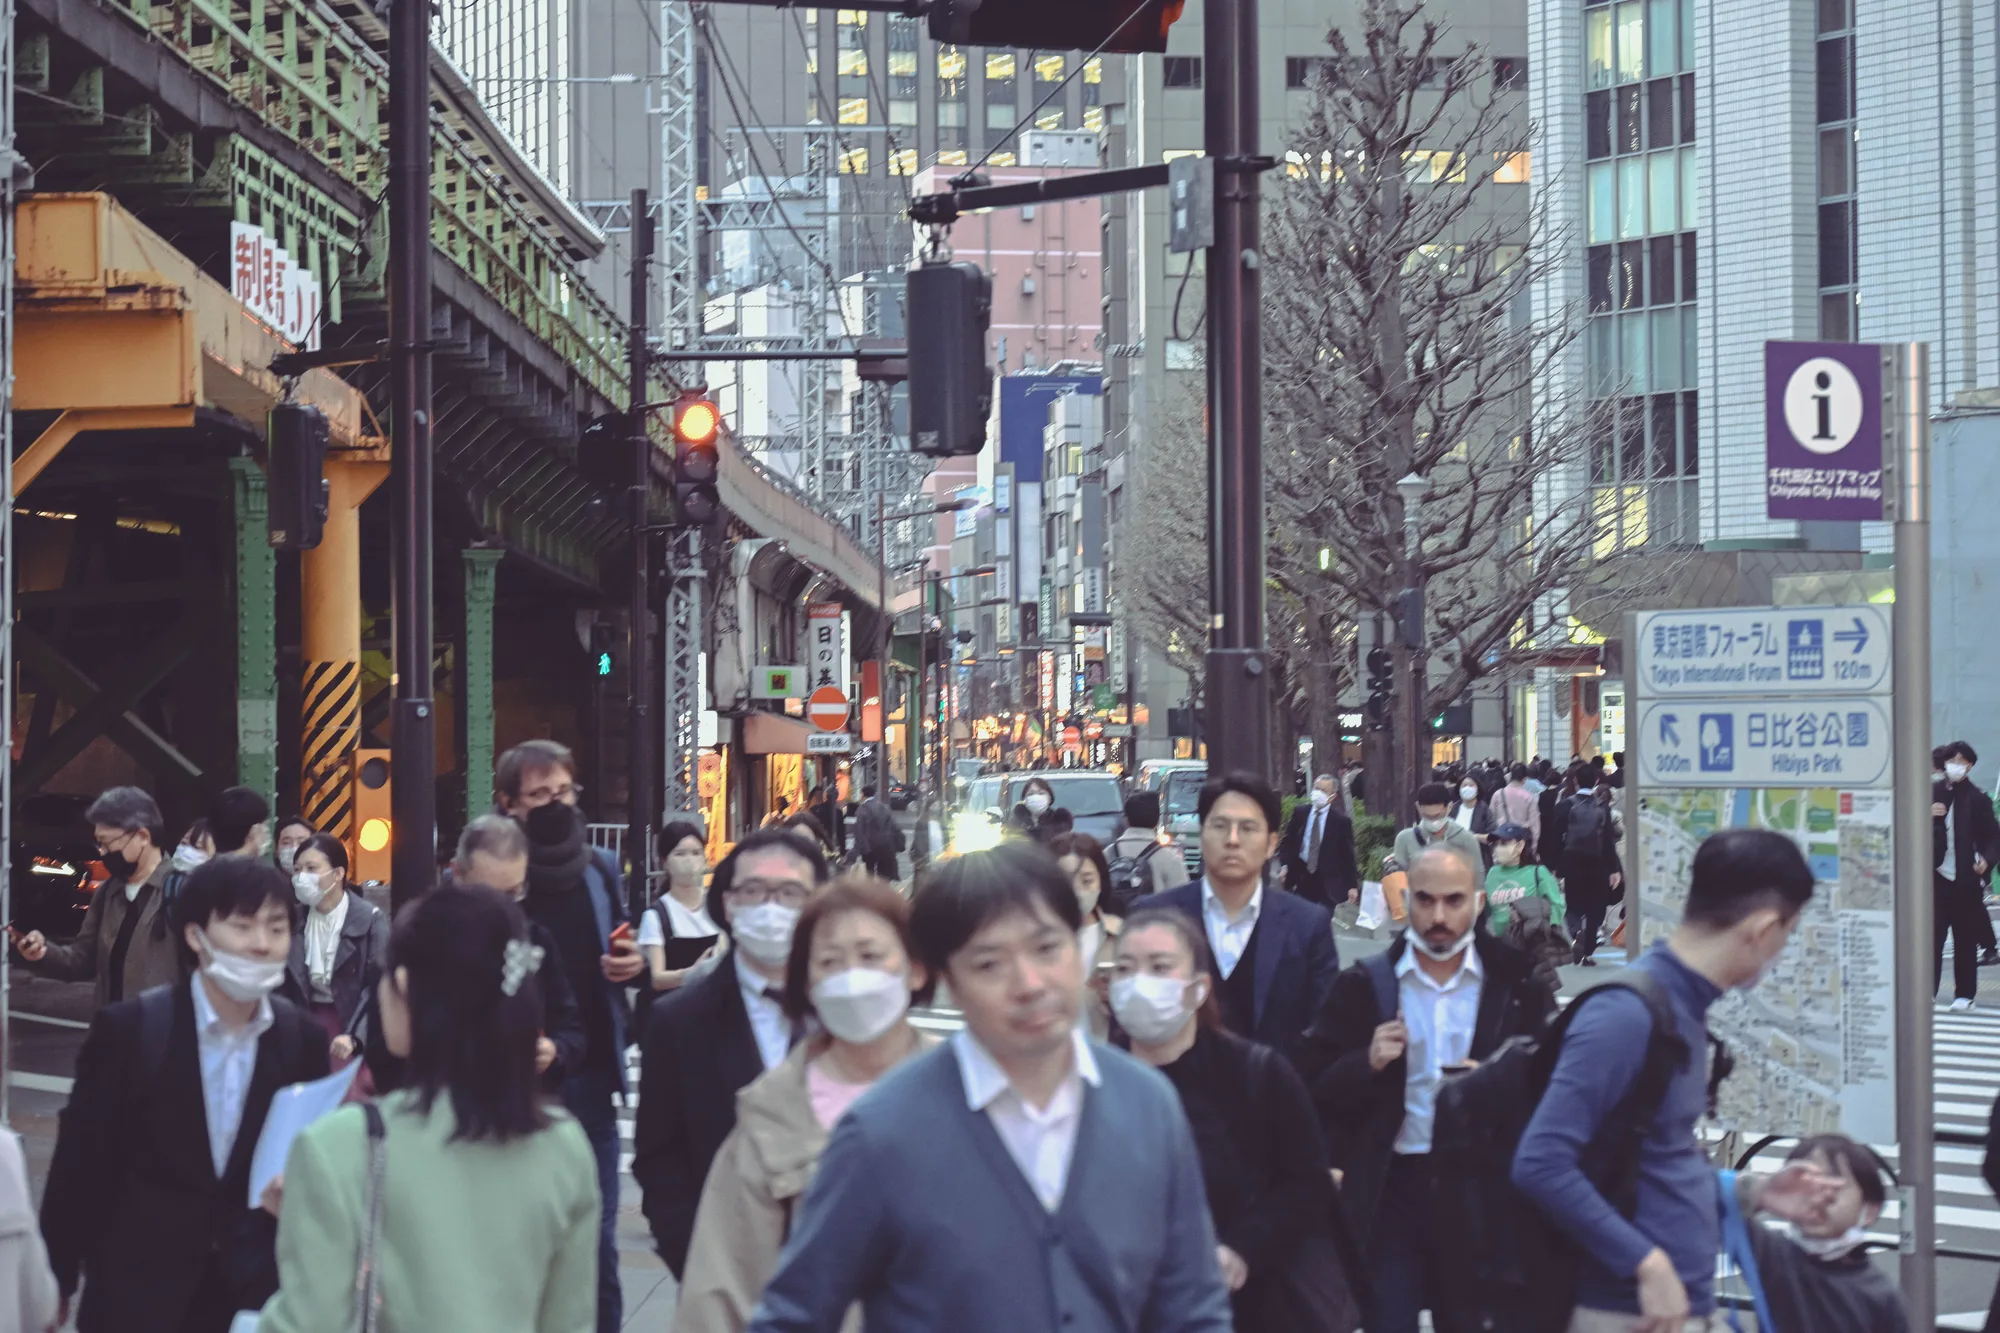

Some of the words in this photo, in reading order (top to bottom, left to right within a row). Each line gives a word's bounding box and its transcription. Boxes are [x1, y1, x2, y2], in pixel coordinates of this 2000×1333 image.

[1811, 370, 1837, 441] i
[1769, 484, 1811, 499] Chiyoda
[1813, 485, 1832, 500] City
[1834, 485, 1857, 499] Area
[1859, 485, 1882, 500] Map
[1653, 622, 1779, 658] 東京国際フォーラム
[1650, 665, 1680, 687] Tokyo
[1682, 664, 1745, 683] International
[1748, 663, 1781, 682] Forum
[1833, 661, 1871, 679] 120m
[1748, 712, 1869, 748] 日比谷公園
[1772, 755, 1809, 777] Hibiya
[1813, 754, 1843, 773] Park
[1490, 887, 1526, 906] GUESS
